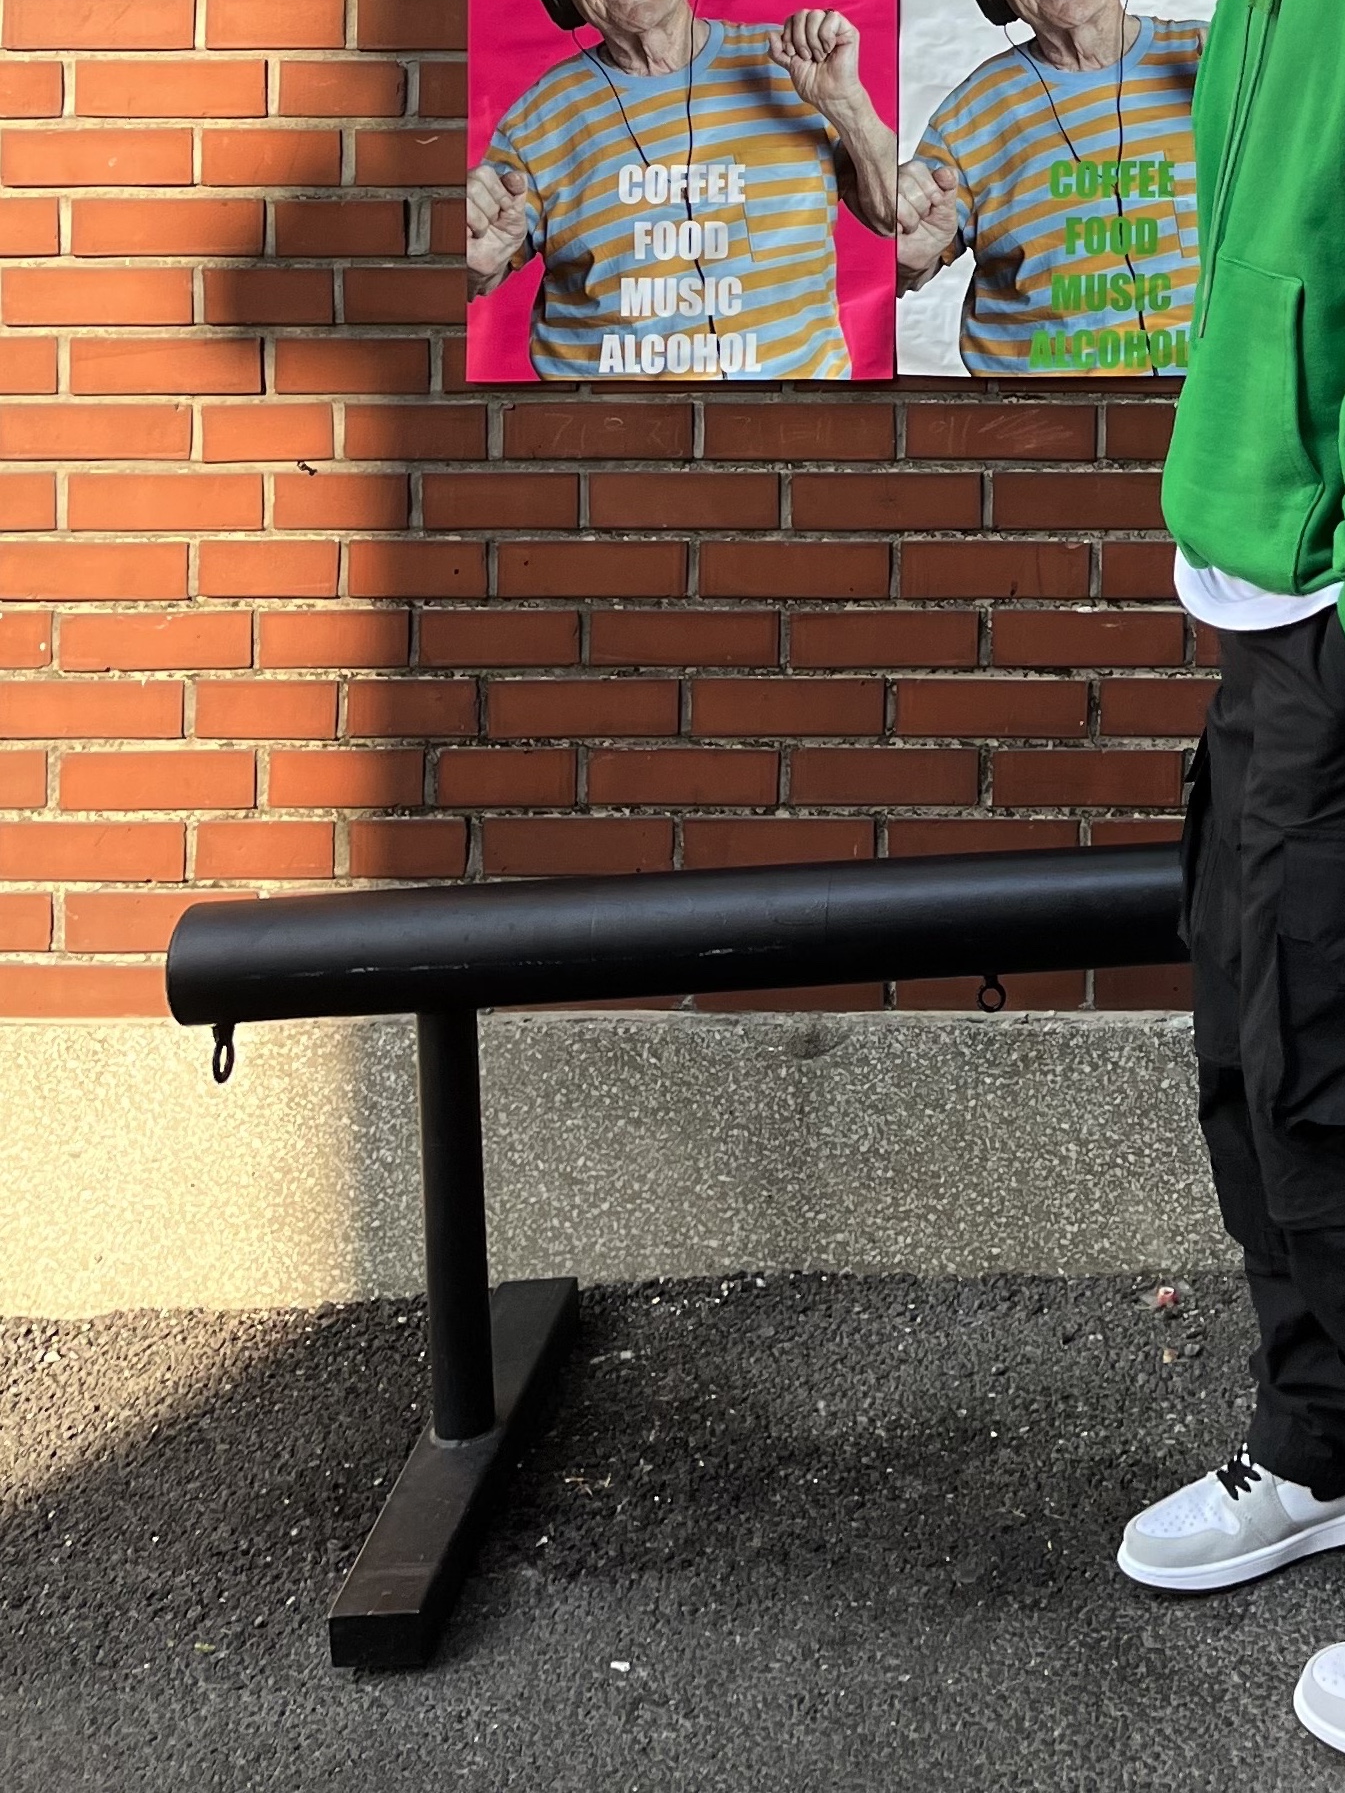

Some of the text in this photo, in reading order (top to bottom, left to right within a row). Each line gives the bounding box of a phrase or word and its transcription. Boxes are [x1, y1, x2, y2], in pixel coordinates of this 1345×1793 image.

[619, 164, 745, 204] COFFEE
[1050, 160, 1176, 198] COFFEE
[634, 221, 728, 260] FOOD
[1065, 216, 1158, 255] FOOD
[621, 277, 742, 317] MUSIC
[1051, 273, 1171, 311] MUSIC
[599, 334, 761, 374] ALCOHOL
[1029, 329, 1188, 369] ALCOHOL
